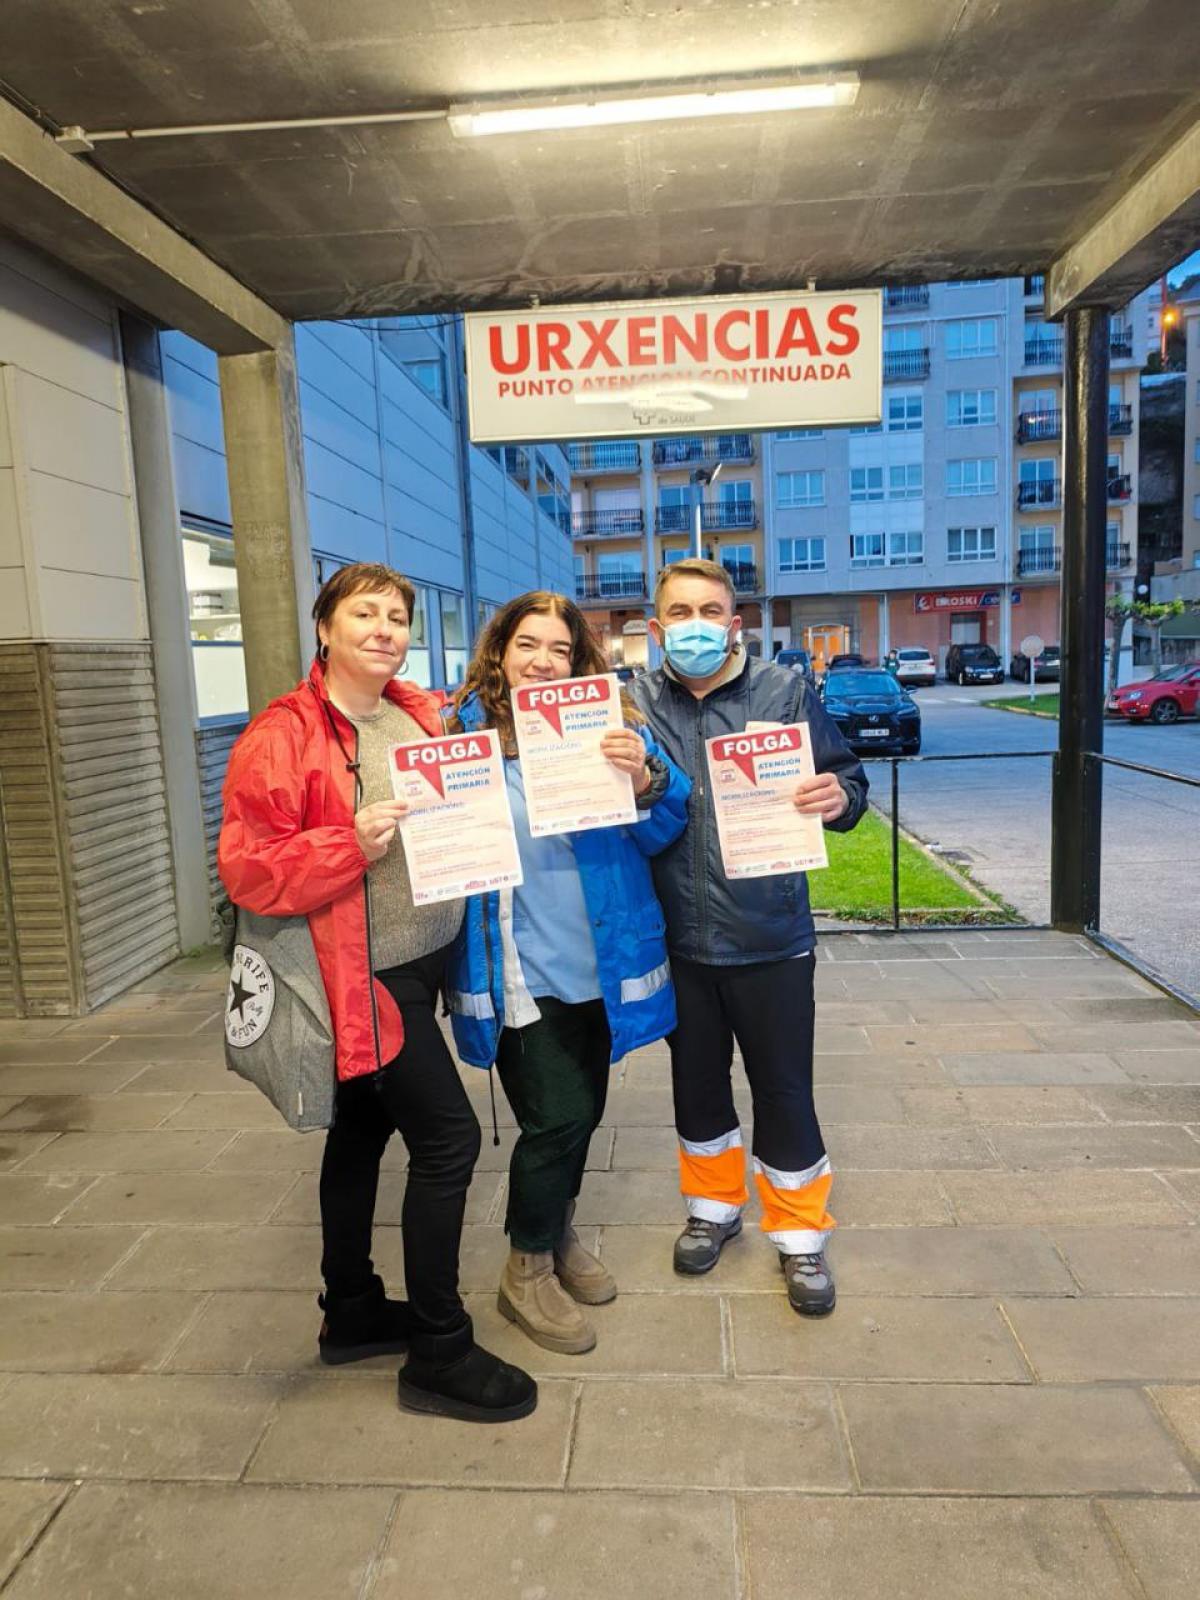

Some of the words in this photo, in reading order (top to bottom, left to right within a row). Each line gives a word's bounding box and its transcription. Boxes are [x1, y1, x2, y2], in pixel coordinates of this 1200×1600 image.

[489, 304, 860, 375] URXENCIAS
[499, 378, 574, 398] PUNTO
[700, 363, 852, 386] CONTINUADA
[528, 683, 601, 708] FOLGA
[566, 720, 607, 731] PRIMARIA
[407, 740, 483, 767] FOLGA
[722, 733, 793, 757] FOLGA
[447, 779, 489, 791] PRIMARIA
[759, 769, 800, 780] PRIMARIA
